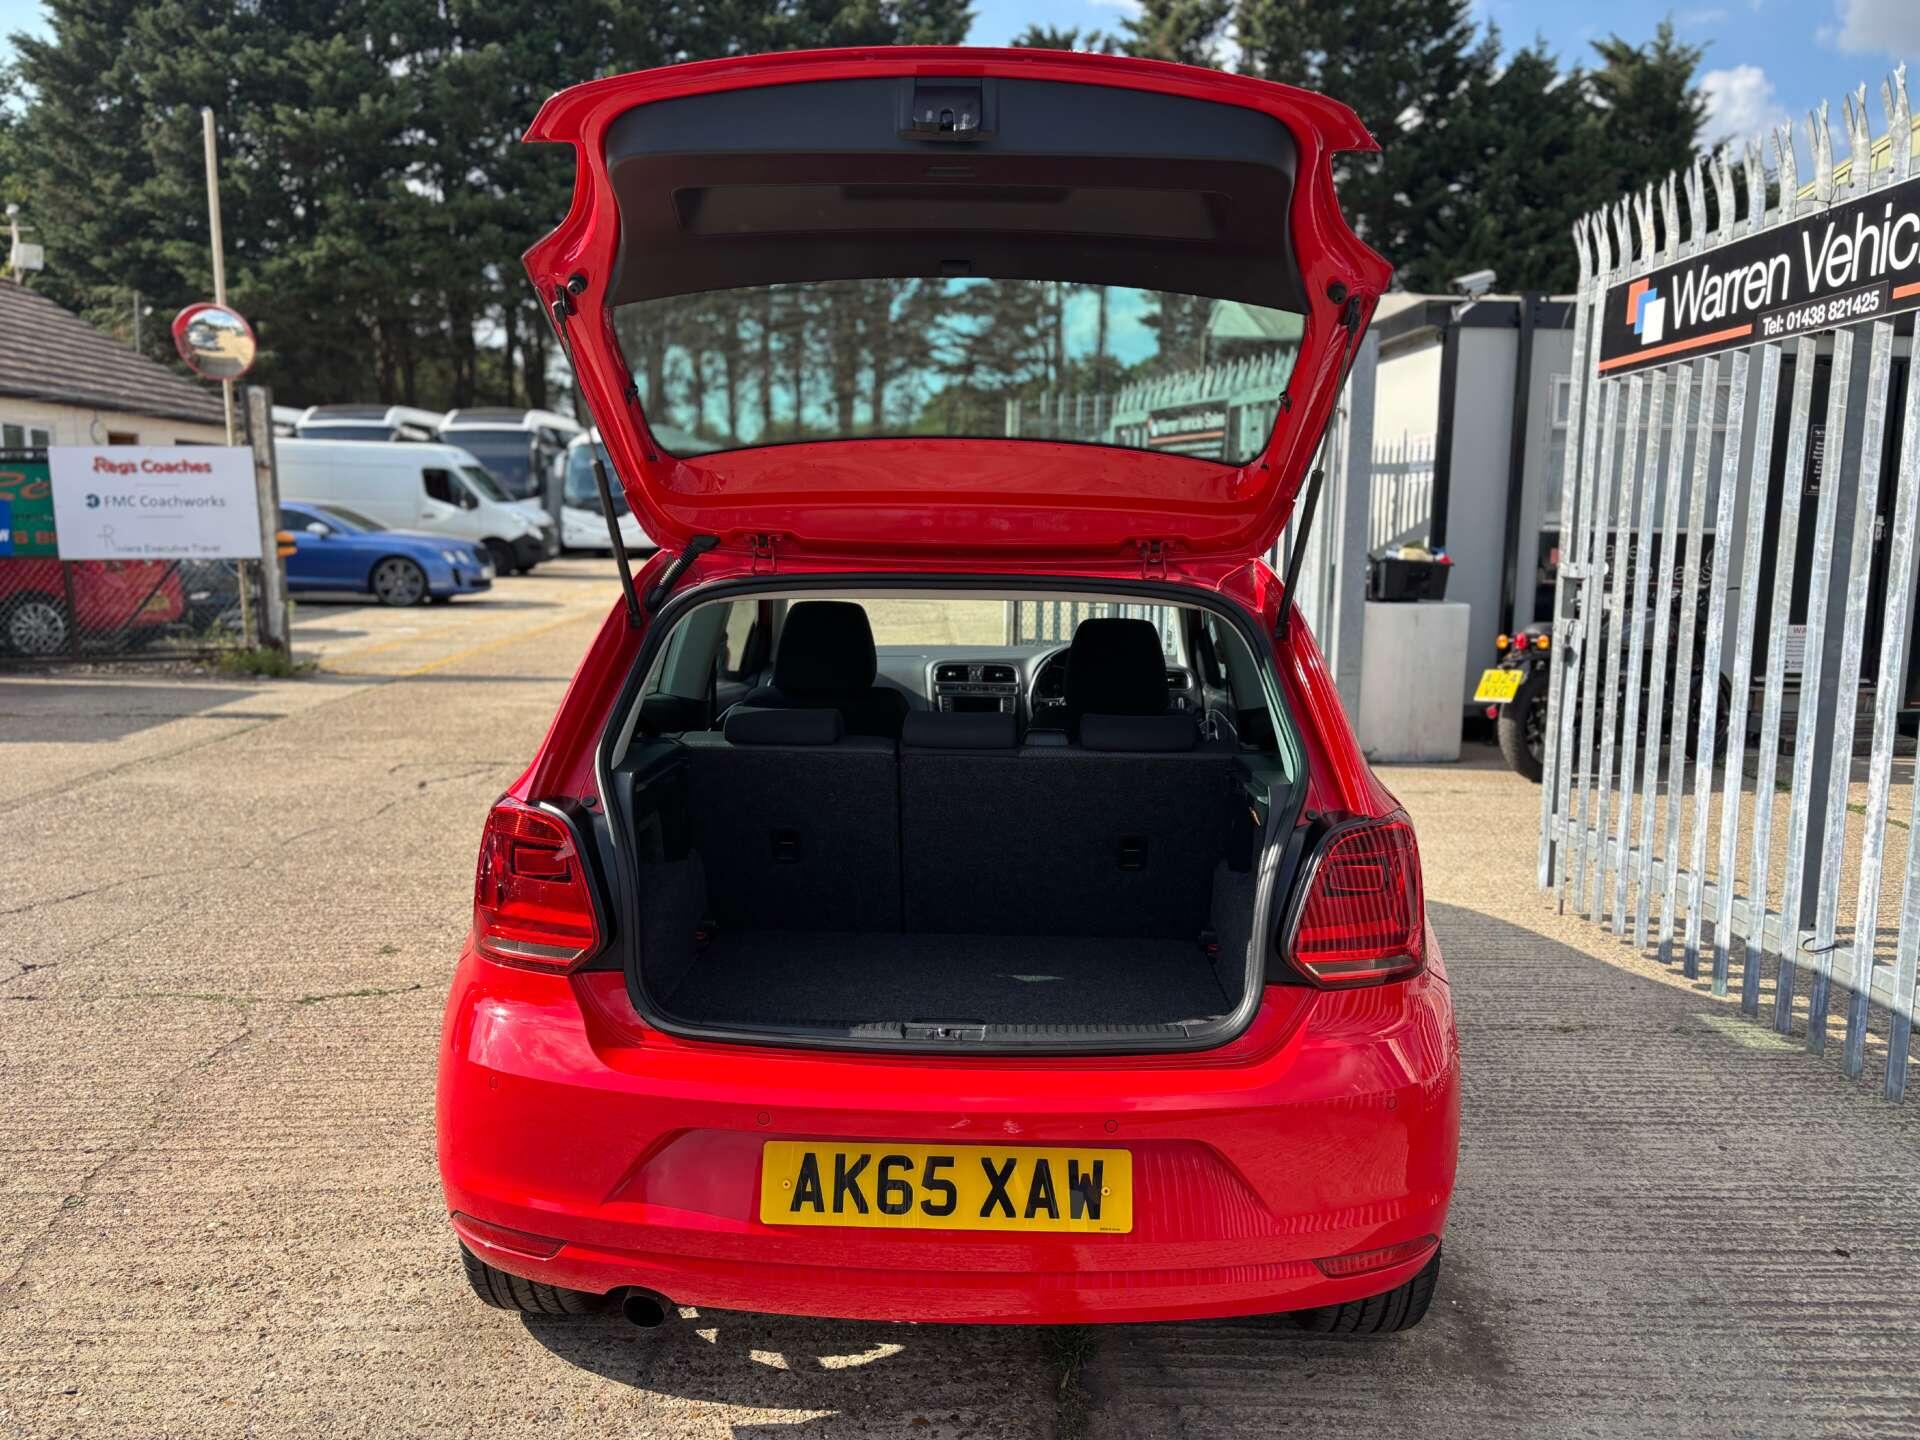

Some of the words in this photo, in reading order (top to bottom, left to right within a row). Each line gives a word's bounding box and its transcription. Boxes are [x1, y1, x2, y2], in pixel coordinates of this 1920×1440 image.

[1672, 253, 1791, 330] Warren
[1802, 202, 1920, 293] Vehic
[1762, 314, 1784, 336] Tel:
[1786, 304, 1826, 330] 01438
[1828, 290, 1880, 321] 821425
[141, 459, 213, 474] Coaches
[103, 495, 136, 507] FMC
[139, 494, 226, 508] Coachworks
[790, 1152, 957, 1216] AK65
[979, 1157, 1104, 1219] XAW
